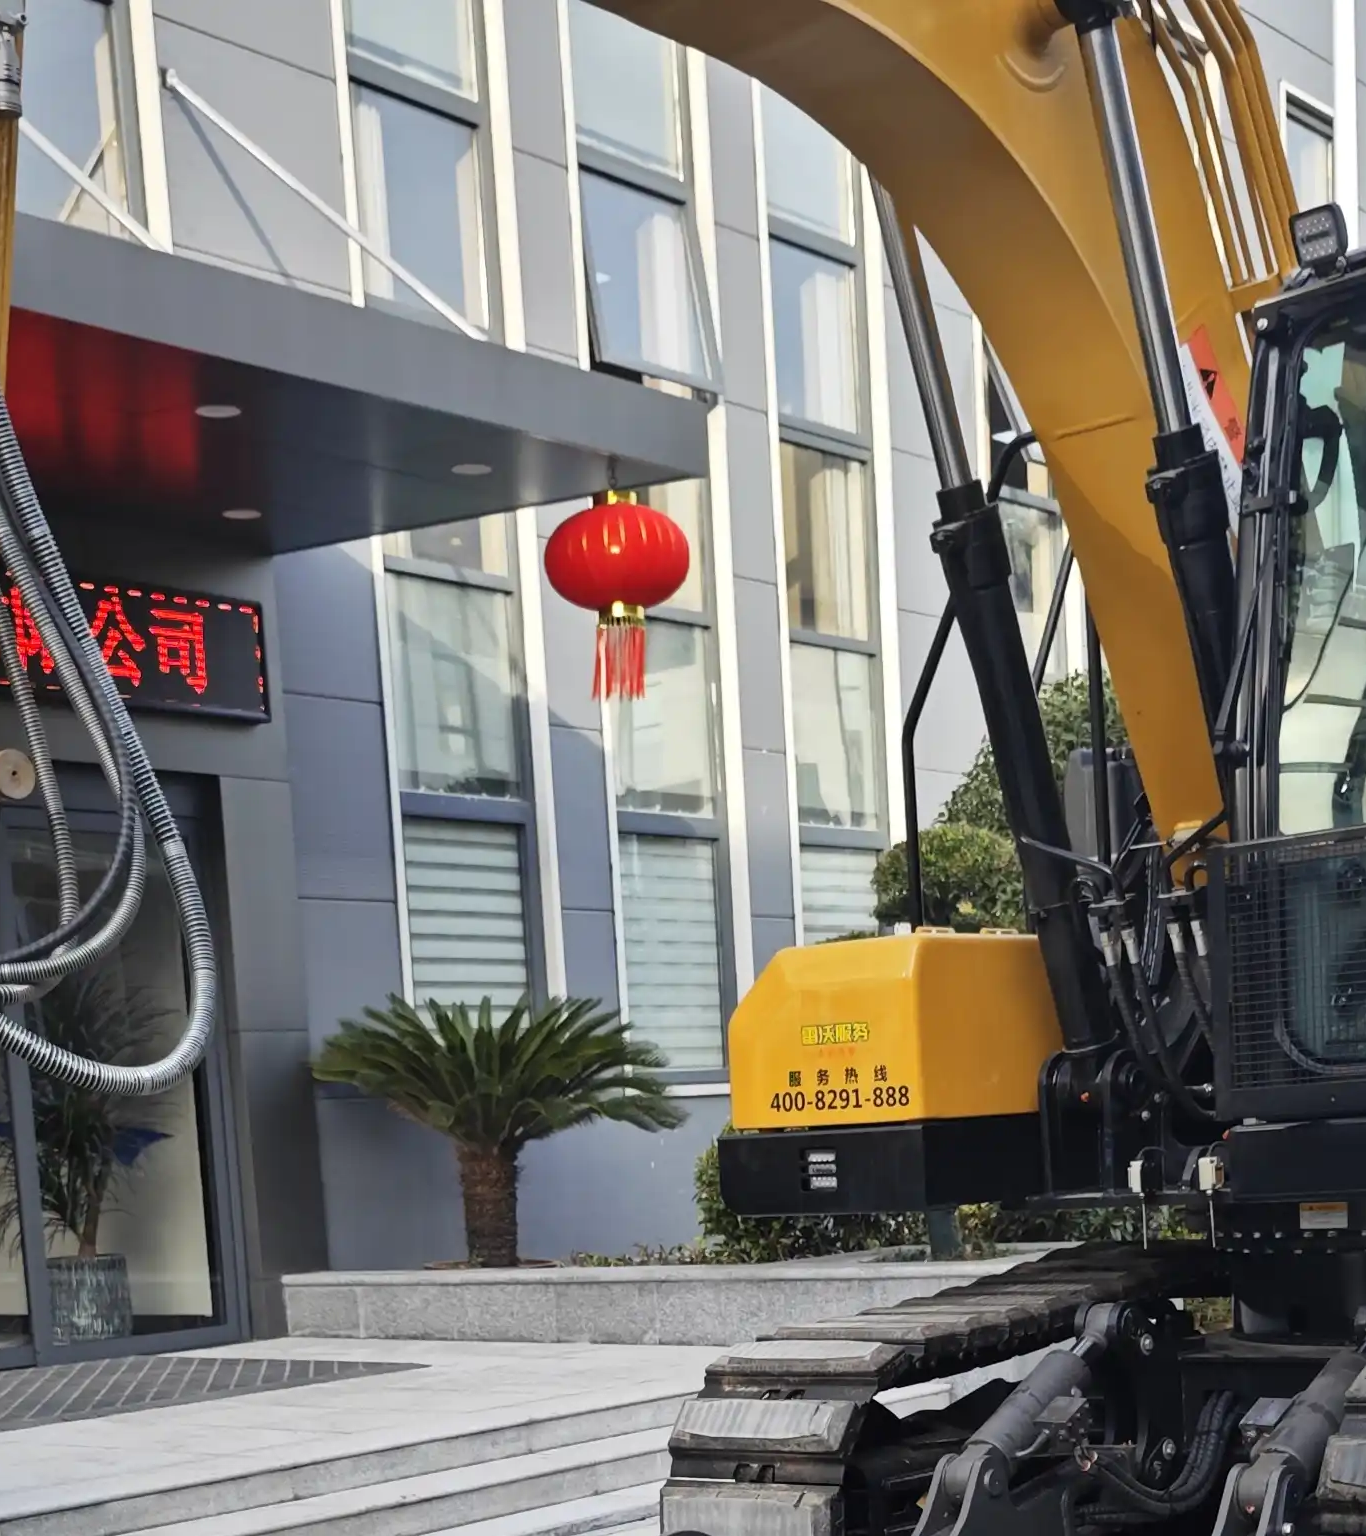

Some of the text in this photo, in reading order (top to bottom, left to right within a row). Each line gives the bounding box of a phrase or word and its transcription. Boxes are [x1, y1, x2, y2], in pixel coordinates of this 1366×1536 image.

[788, 1064, 888, 1087] 服务热线
[770, 1085, 910, 1113] 400-8291-888
